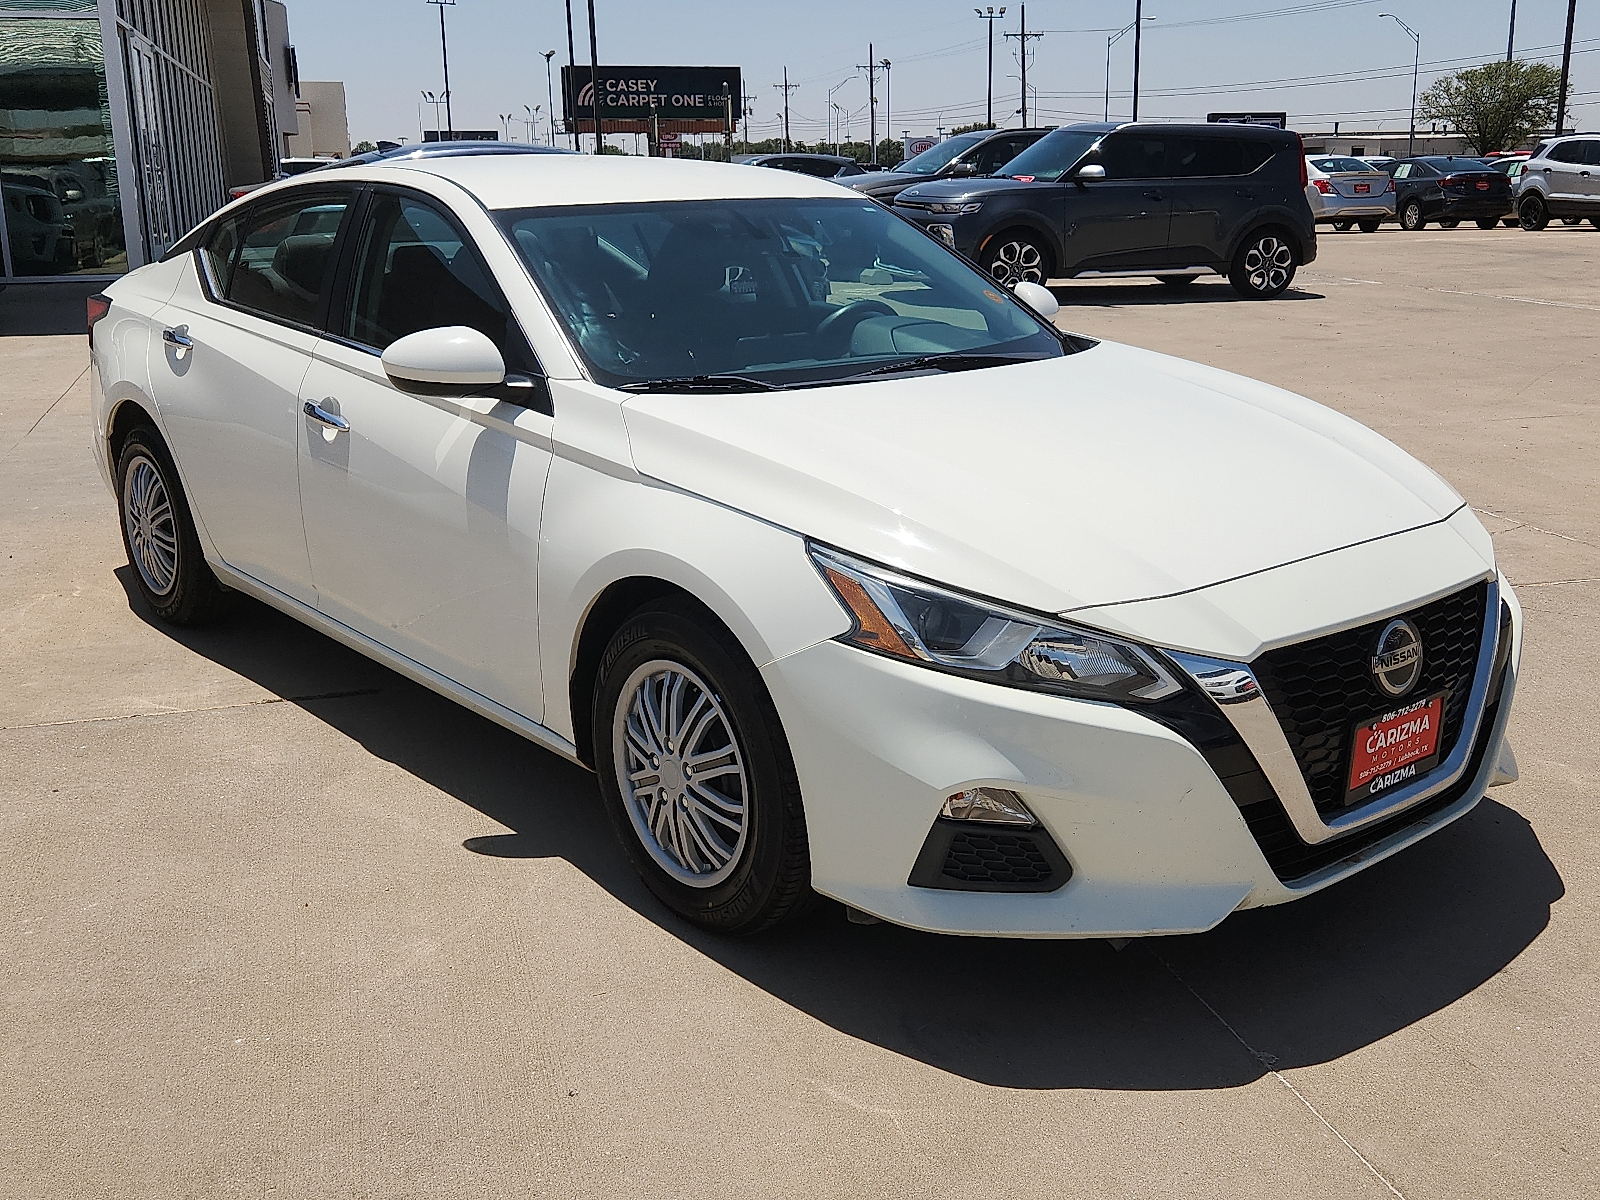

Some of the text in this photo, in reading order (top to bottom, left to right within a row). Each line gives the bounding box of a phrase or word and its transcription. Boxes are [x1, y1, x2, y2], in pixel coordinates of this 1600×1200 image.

[606, 79, 658, 92] CASEY
[606, 94, 705, 107] CARPET ONE
[1380, 645, 1418, 669] NISSAN
[1381, 698, 1427, 723] 806-712-2279
[1366, 714, 1430, 754] CARIZMA
[1359, 759, 1392, 779] 806-712-2279
[1421, 743, 1429, 753] TX
[1371, 736, 1420, 764] MOTORS
[1369, 763, 1416, 794] CARIZMA
